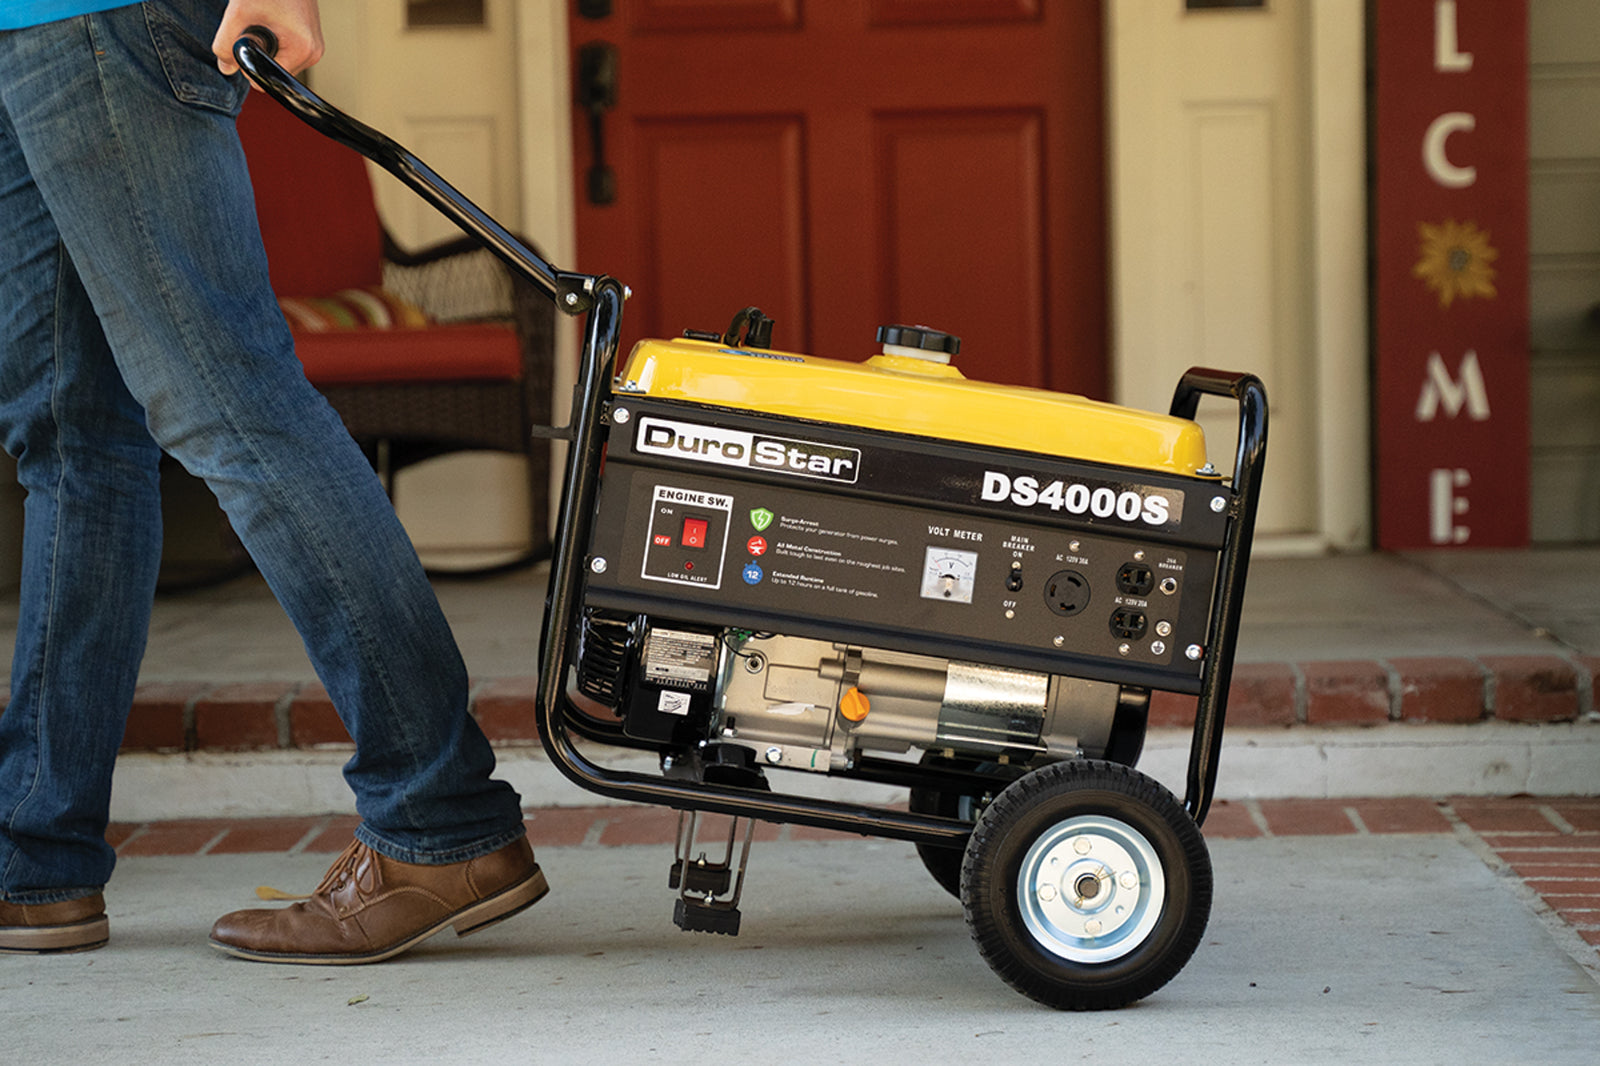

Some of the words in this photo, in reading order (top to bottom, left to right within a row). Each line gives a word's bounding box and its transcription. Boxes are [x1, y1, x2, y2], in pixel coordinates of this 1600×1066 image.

[658, 489, 705, 504] ENGINE
[707, 496, 728, 507] SW.
[981, 471, 1169, 525] DS4000S
[660, 507, 673, 515] ON
[928, 525, 950, 537] VOLT
[953, 529, 983, 541] METER
[654, 537, 670, 545] OFF
[1010, 535, 1029, 544] MAIN
[1002, 541, 1035, 552] BREAKER
[1012, 550, 1023, 558] ON
[667, 571, 679, 579] LOW
[690, 575, 708, 583] ALERT
[746, 570, 759, 580] 12
[1003, 600, 1016, 608] OFF
